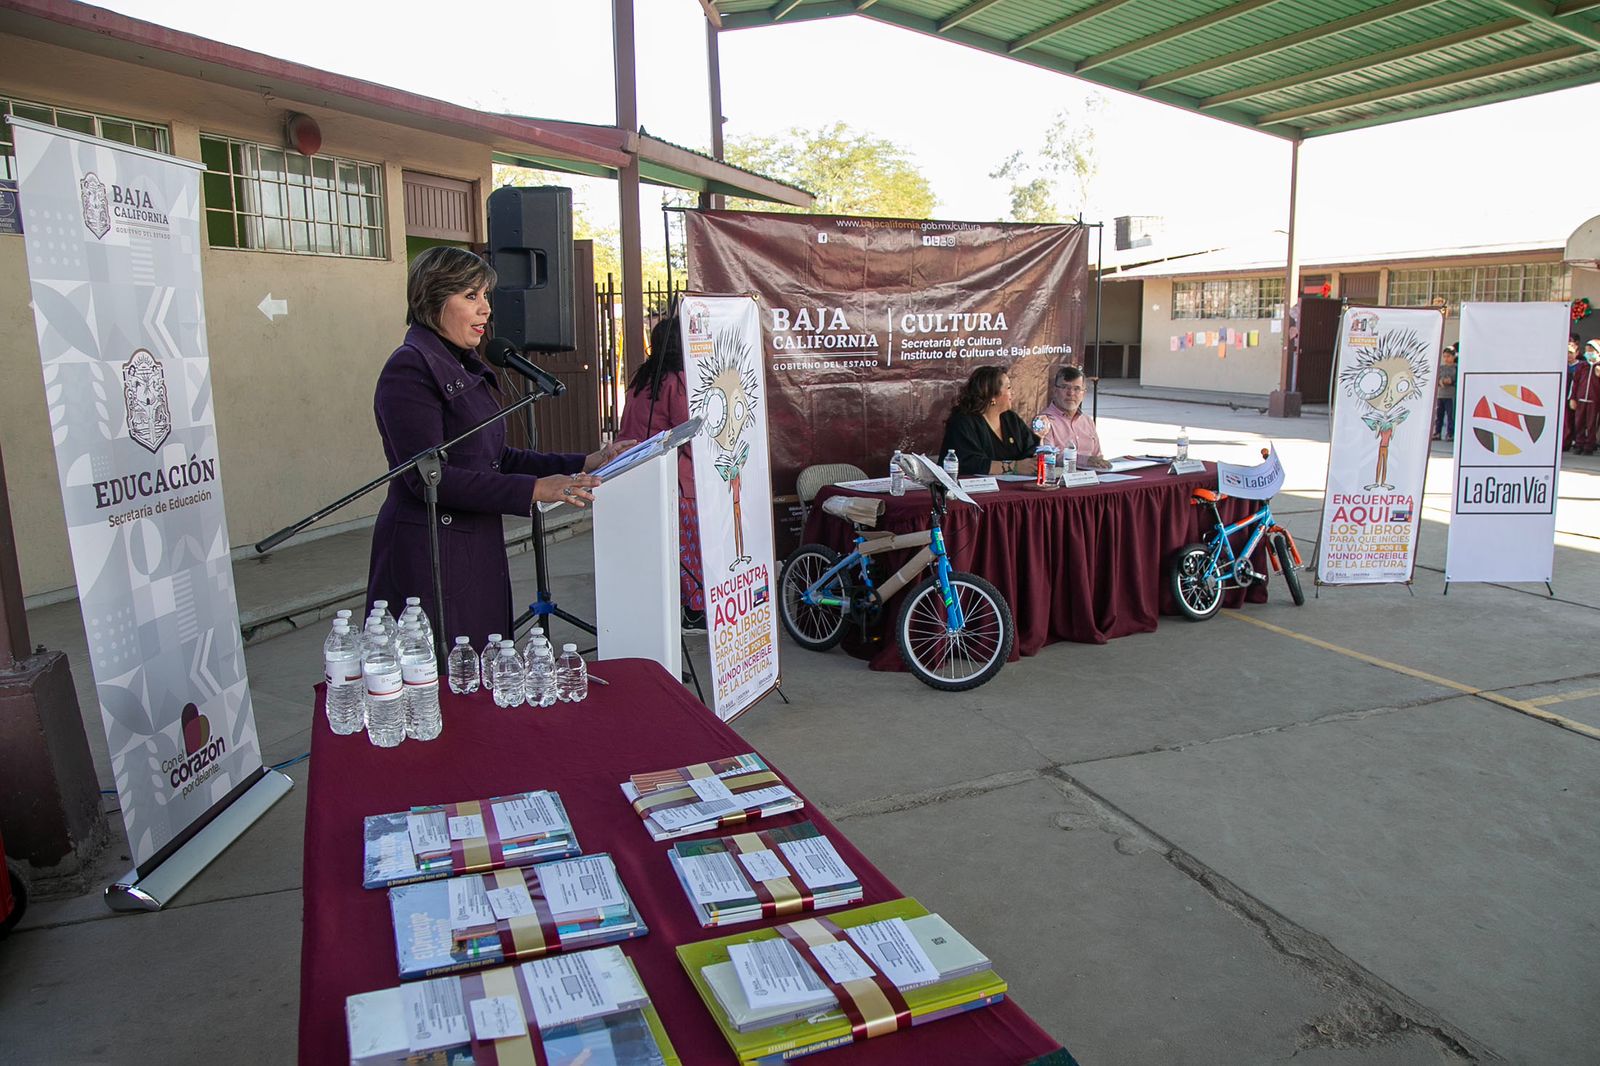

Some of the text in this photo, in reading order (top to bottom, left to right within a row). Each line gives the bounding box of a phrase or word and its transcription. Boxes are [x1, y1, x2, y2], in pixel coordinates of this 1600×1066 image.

[112, 184, 153, 209] BAJA
[114, 206, 169, 225] CALIFORNIA
[771, 307, 850, 334] BAJA
[901, 311, 1009, 333] CULTURA
[772, 334, 879, 350] CALIFORNIA
[901, 336, 1002, 349] Secretaría de Cultura
[900, 344, 1072, 360] Instituto de Cultura de Baja California
[773, 360, 878, 371] GOBIERNO DEL ESTADO
[92, 454, 215, 509] EDUCACIÓN
[108, 489, 212, 528] Secretaría de Educación
[1333, 494, 1413, 505] ENCUENTRA
[1329, 535, 1410, 543] PARA QUE INICIES
[1330, 524, 1411, 536] LOS LIBROS
[1327, 552, 1363, 560] MUNDO
[1329, 544, 1343, 552] TU
[1326, 560, 1341, 568] DE
[1345, 560, 1357, 568] LA
[710, 563, 769, 604] ENCUENTRA
[714, 605, 771, 650] LOS LIBROS
[715, 620, 771, 662] PARA QUE INICIES
[716, 660, 727, 675] TU
[718, 664, 741, 686] MUNDO
[718, 686, 729, 701] DE
[730, 678, 740, 692] LA
[161, 749, 185, 774] Con el
[170, 735, 226, 788] corazón
[182, 780, 195, 799] por
